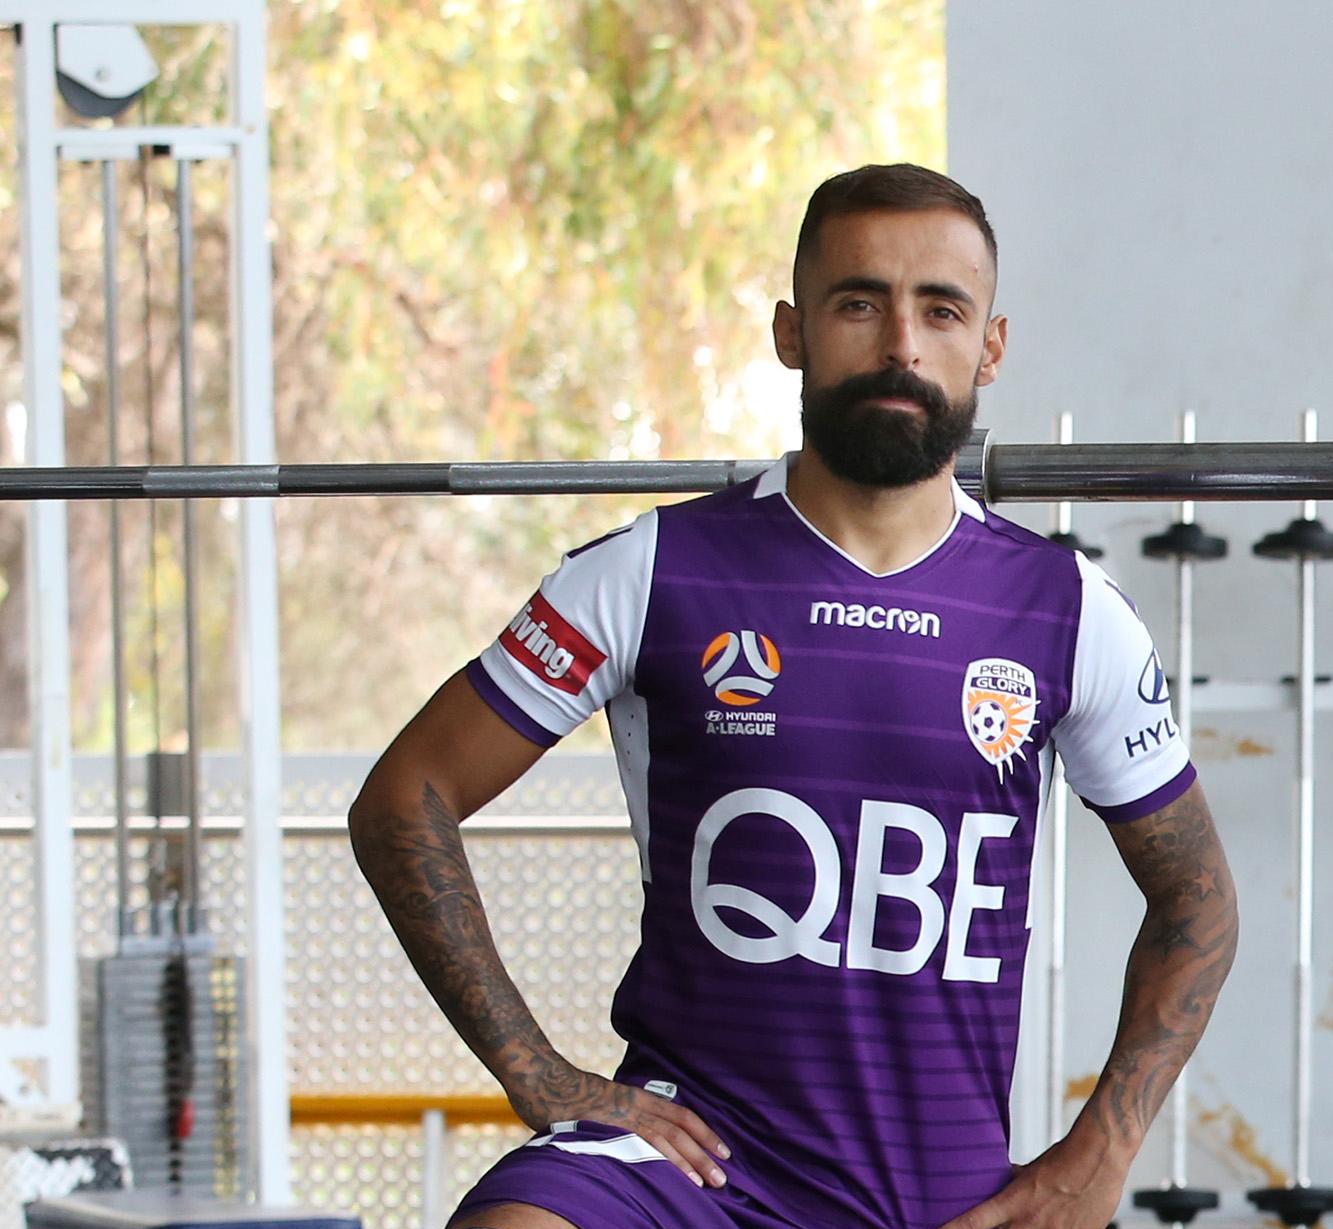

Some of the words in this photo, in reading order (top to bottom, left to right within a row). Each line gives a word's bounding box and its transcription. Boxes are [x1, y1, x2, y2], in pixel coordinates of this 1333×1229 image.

[809, 601, 942, 638] macron
[979, 664, 1026, 682] PERTH
[975, 677, 1030, 696] GLORY
[725, 711, 776, 722] HYUNDAI
[690, 787, 1020, 984] QBE
